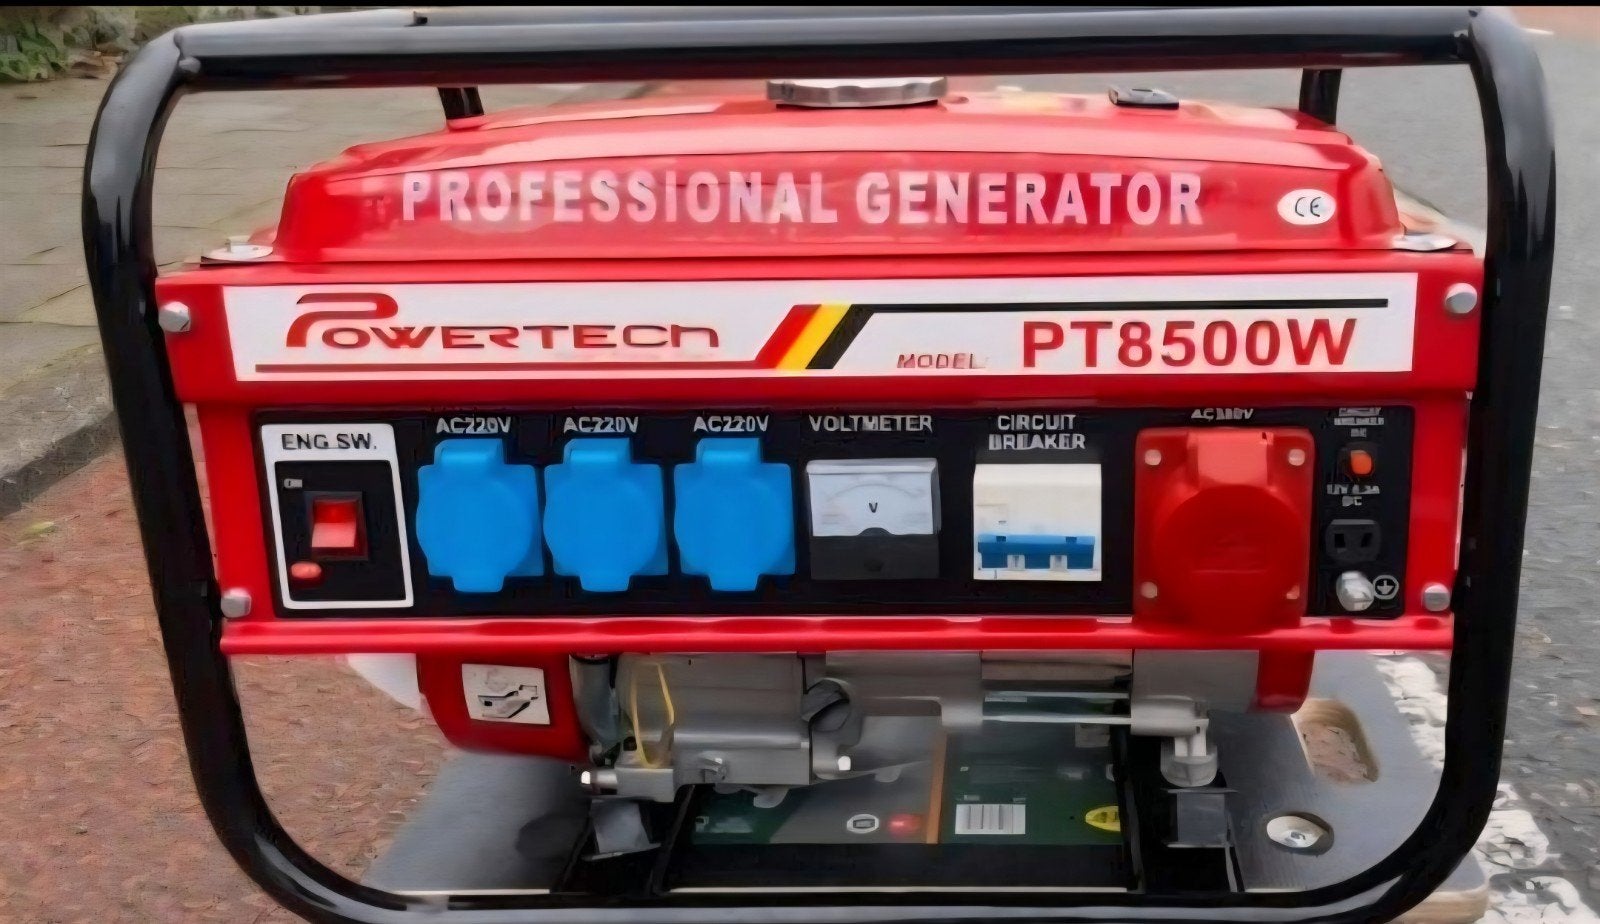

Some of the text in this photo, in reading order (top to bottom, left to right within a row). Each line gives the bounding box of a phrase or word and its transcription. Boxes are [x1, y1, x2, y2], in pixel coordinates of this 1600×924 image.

[402, 167, 1203, 226] PROFESSIONAL GENERATOR
[1022, 318, 1357, 368] PT8500W
[435, 416, 512, 434] AC220V
[563, 416, 639, 434] AC220V
[693, 415, 769, 432] AC220V
[808, 414, 933, 432] VOLTMETER
[997, 414, 1077, 430] CIRCUIT
[281, 432, 377, 450] ENG SW.
[988, 433, 1085, 451] BREAKER
[868, 502, 878, 513] V
